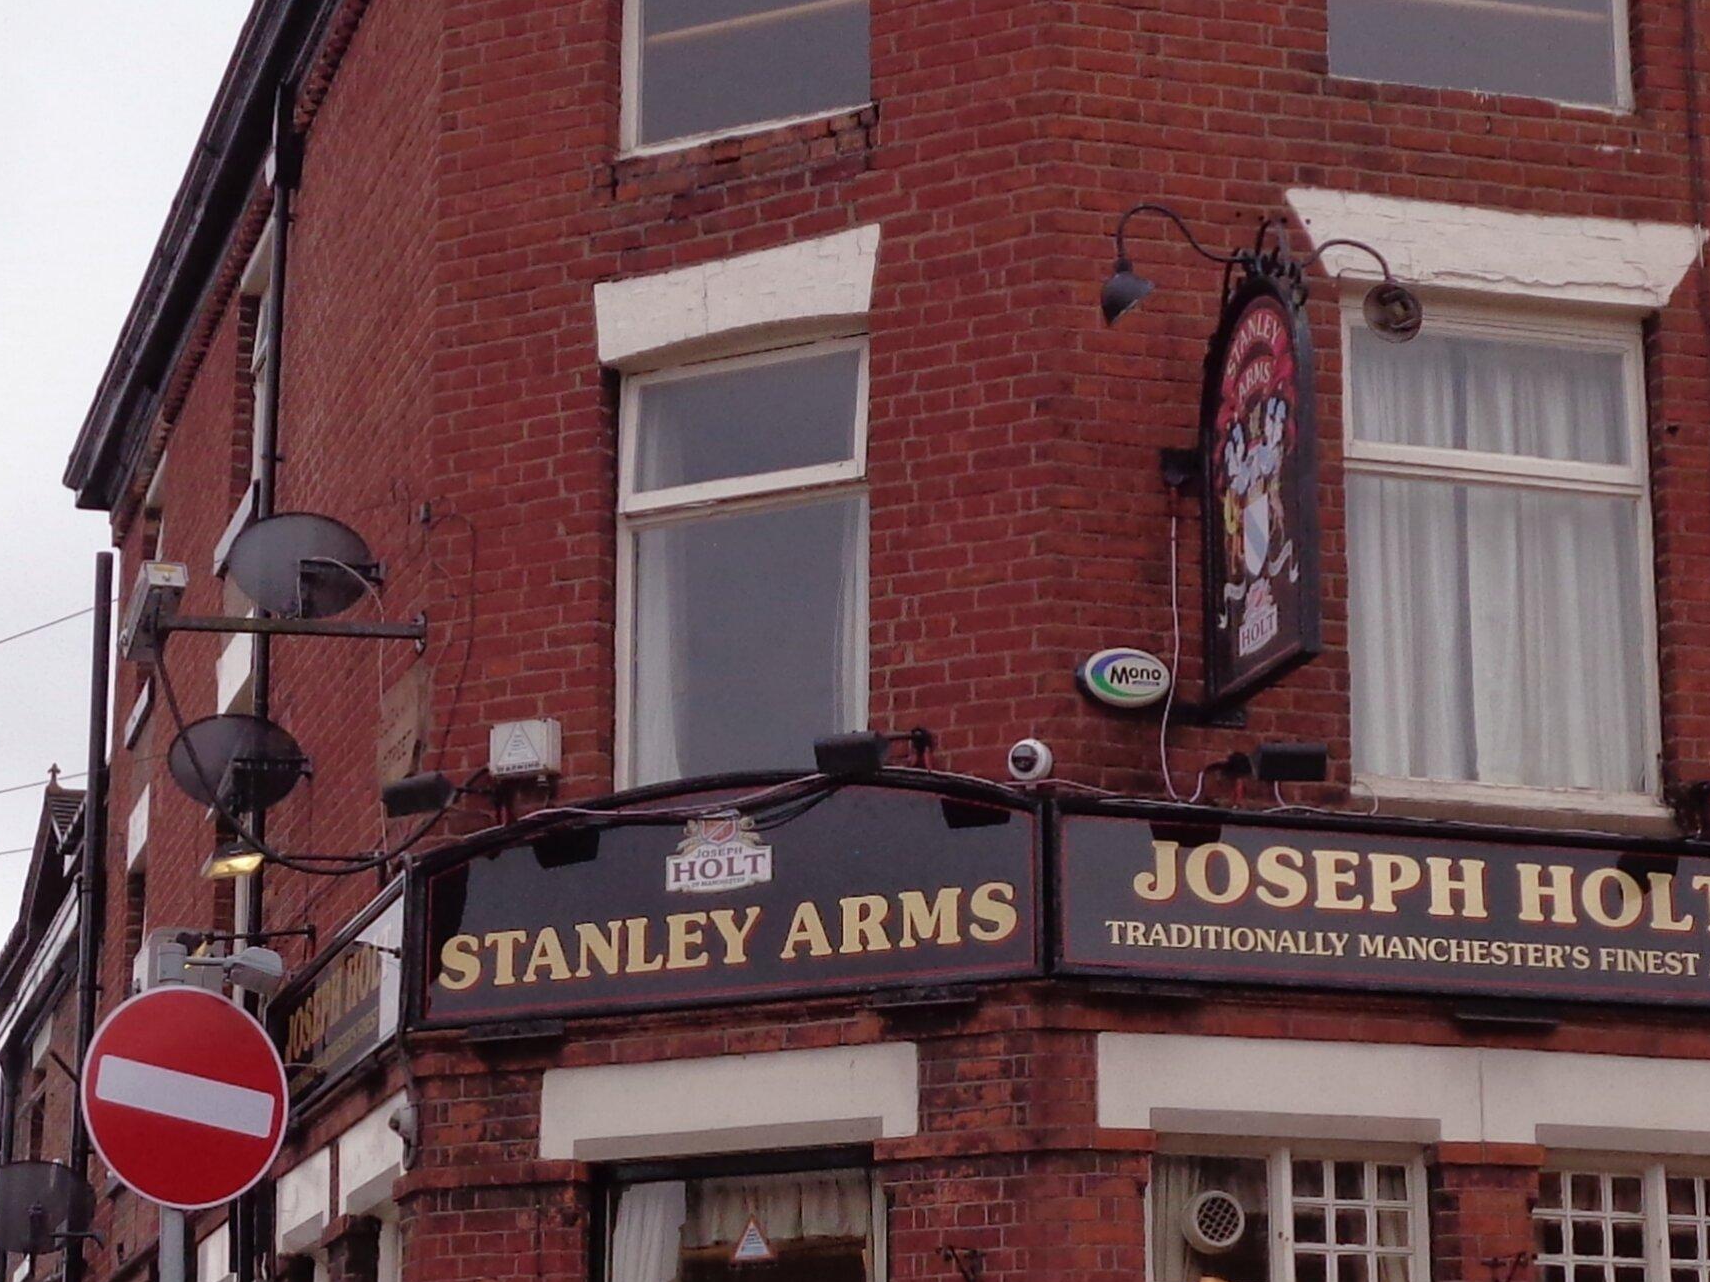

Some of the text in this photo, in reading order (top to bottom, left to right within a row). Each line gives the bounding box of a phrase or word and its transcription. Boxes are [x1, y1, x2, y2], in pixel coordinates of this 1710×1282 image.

[1227, 313, 1281, 378] STANLEY
[1238, 361, 1271, 404] ARMS
[1241, 612, 1276, 648] HOLT
[1109, 666, 1162, 685] Mono
[672, 853, 767, 883] HOLT
[697, 847, 743, 858] JOSEPH
[1133, 838, 1489, 918] JOSEPH
[439, 881, 1018, 991] STANLEY ARMS
[1105, 920, 1350, 957] TRADITIONALLY
[1358, 934, 1591, 970] MANCHESTER'S
[1599, 948, 1700, 976] FINEST
